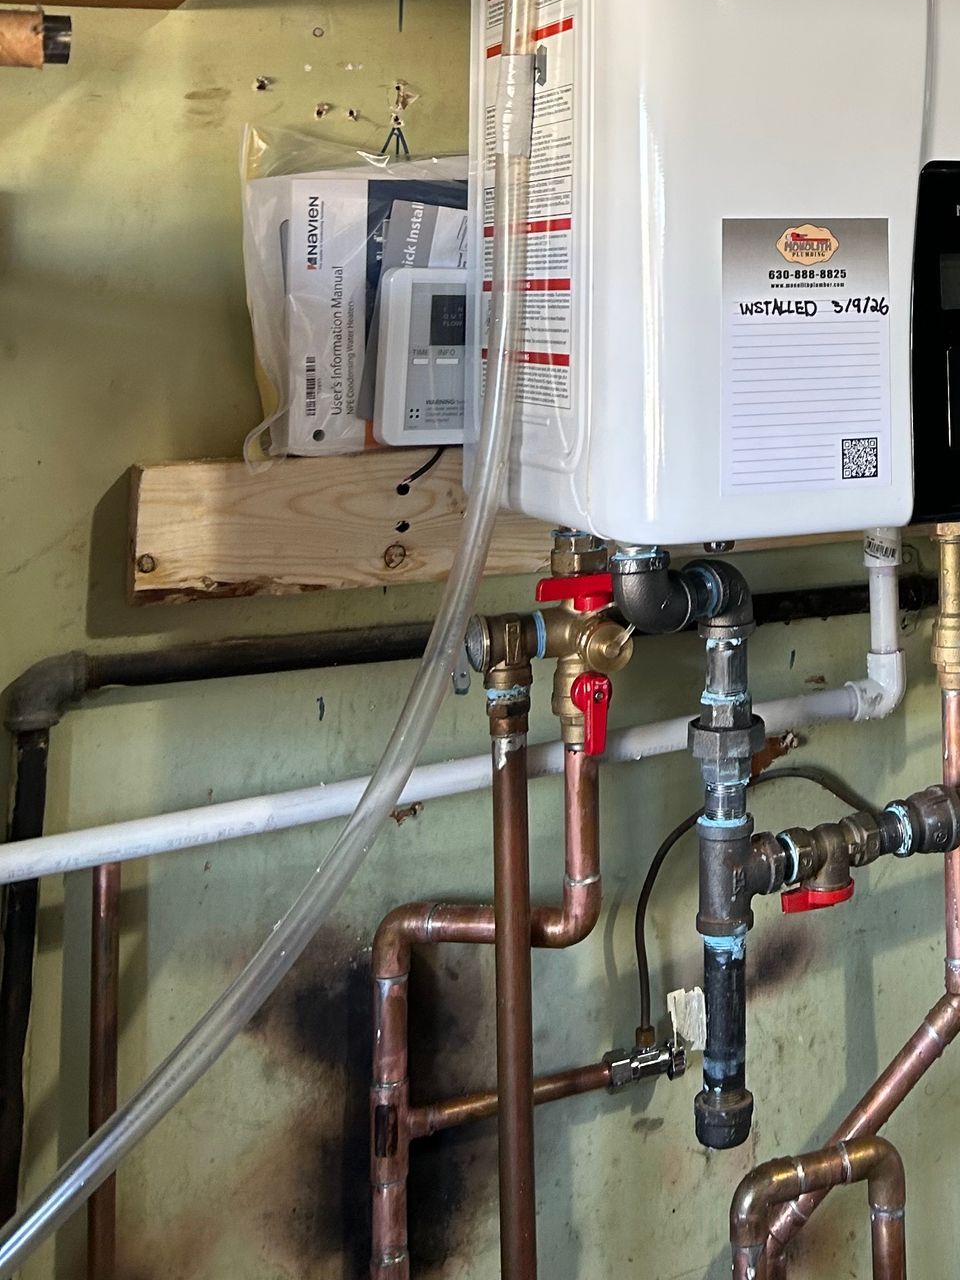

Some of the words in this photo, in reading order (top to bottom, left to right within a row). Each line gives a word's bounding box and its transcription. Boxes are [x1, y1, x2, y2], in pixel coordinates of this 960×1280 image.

[331, 265, 343, 309] Manual
[768, 269, 847, 280] 630-888-8825
[739, 298, 818, 317] INSTALLED
[831, 296, 889, 316] 3/9/26
[330, 310, 343, 380] Information
[346, 329, 354, 352] Water
[346, 352, 355, 399] Condensing
[331, 381, 344, 417] User's
